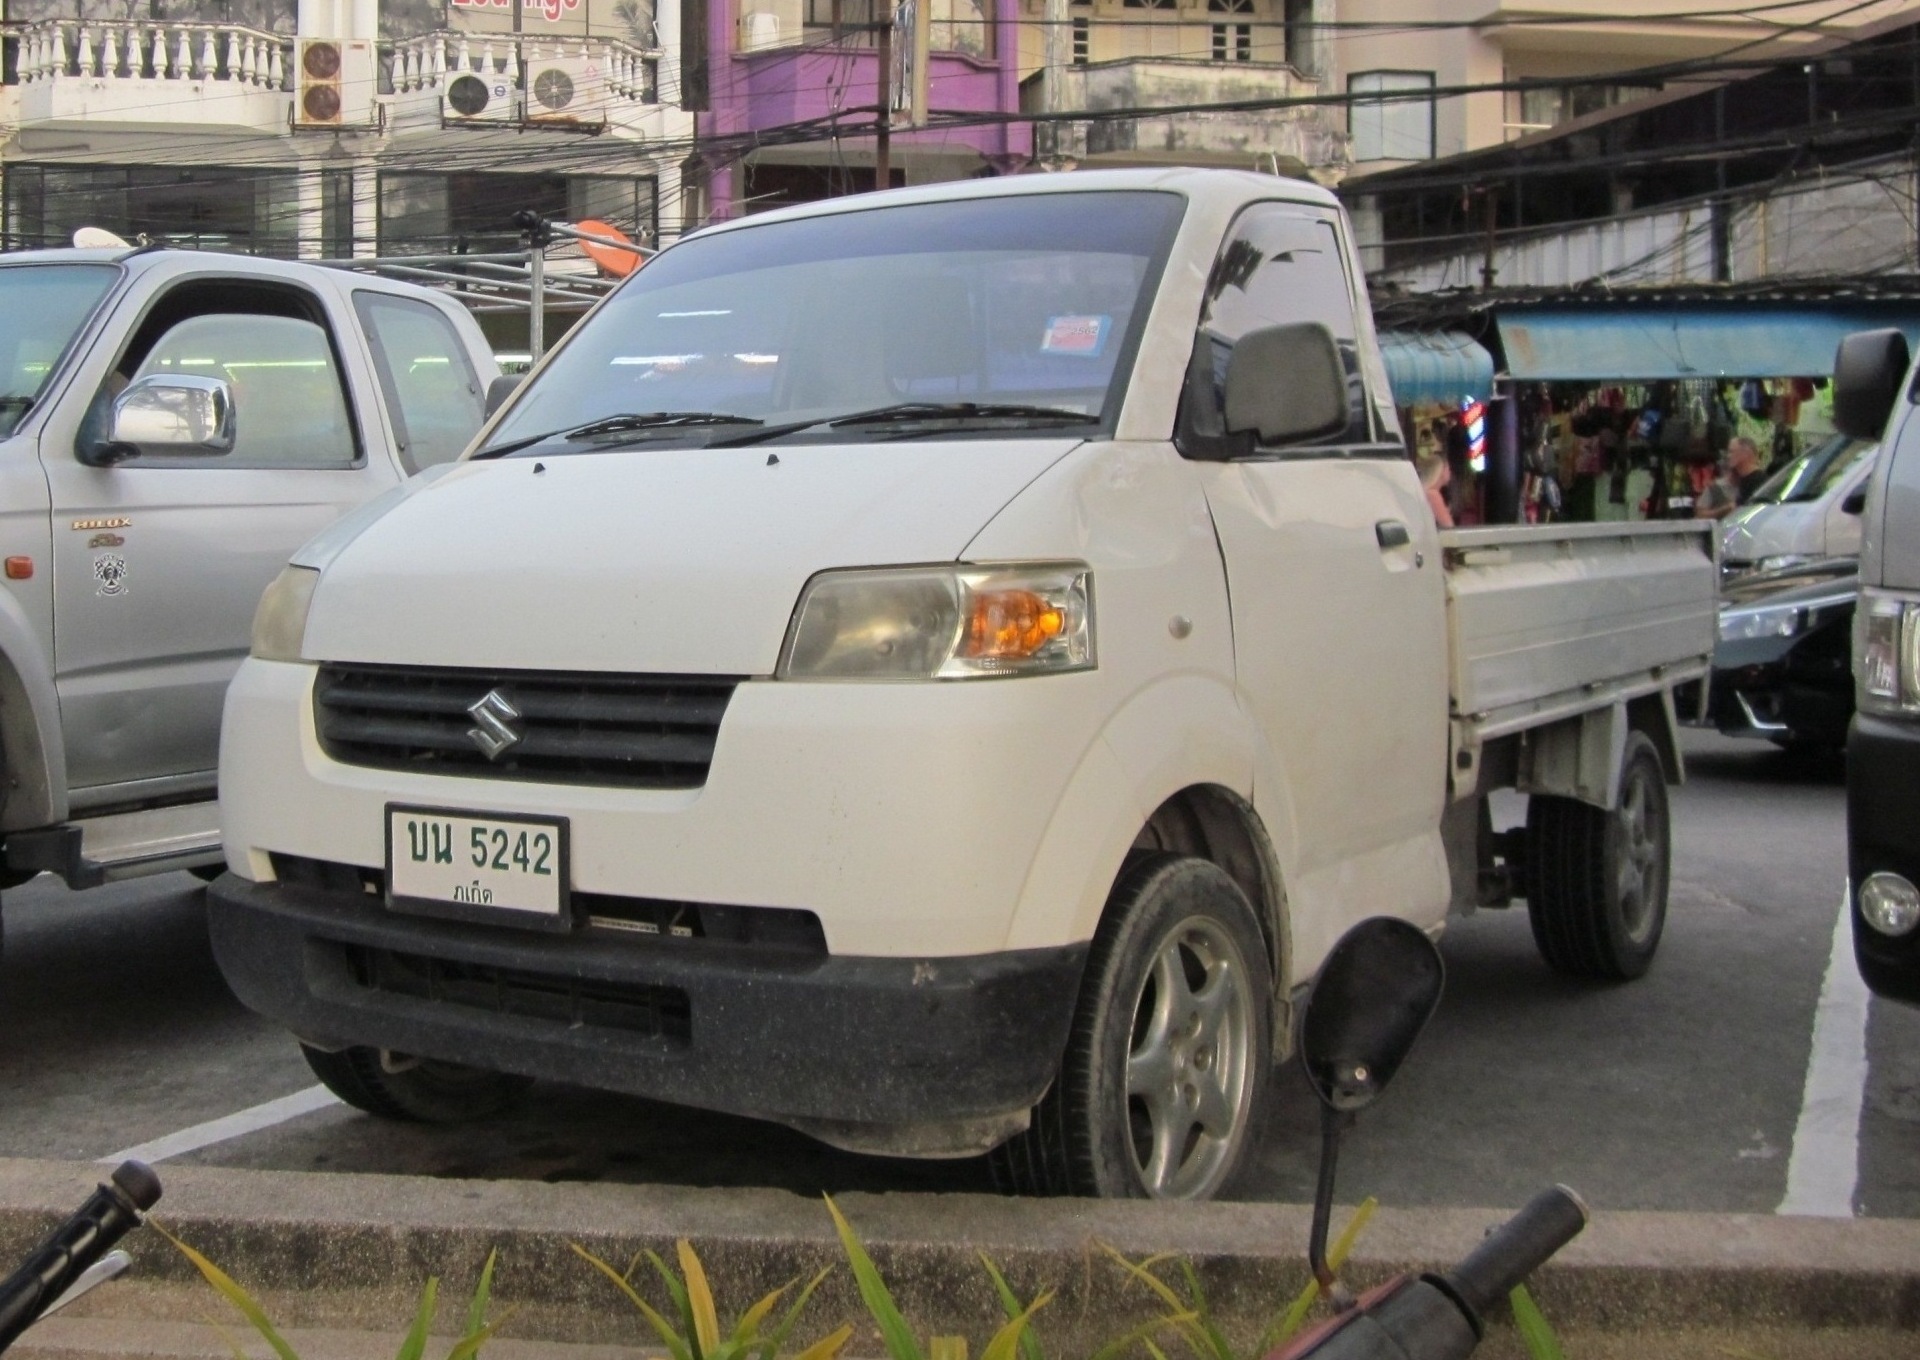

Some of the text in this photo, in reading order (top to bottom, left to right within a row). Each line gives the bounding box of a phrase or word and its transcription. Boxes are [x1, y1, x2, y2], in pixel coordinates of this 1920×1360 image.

[72, 518, 132, 530] HILUX
[408, 821, 552, 875] บน 5242
